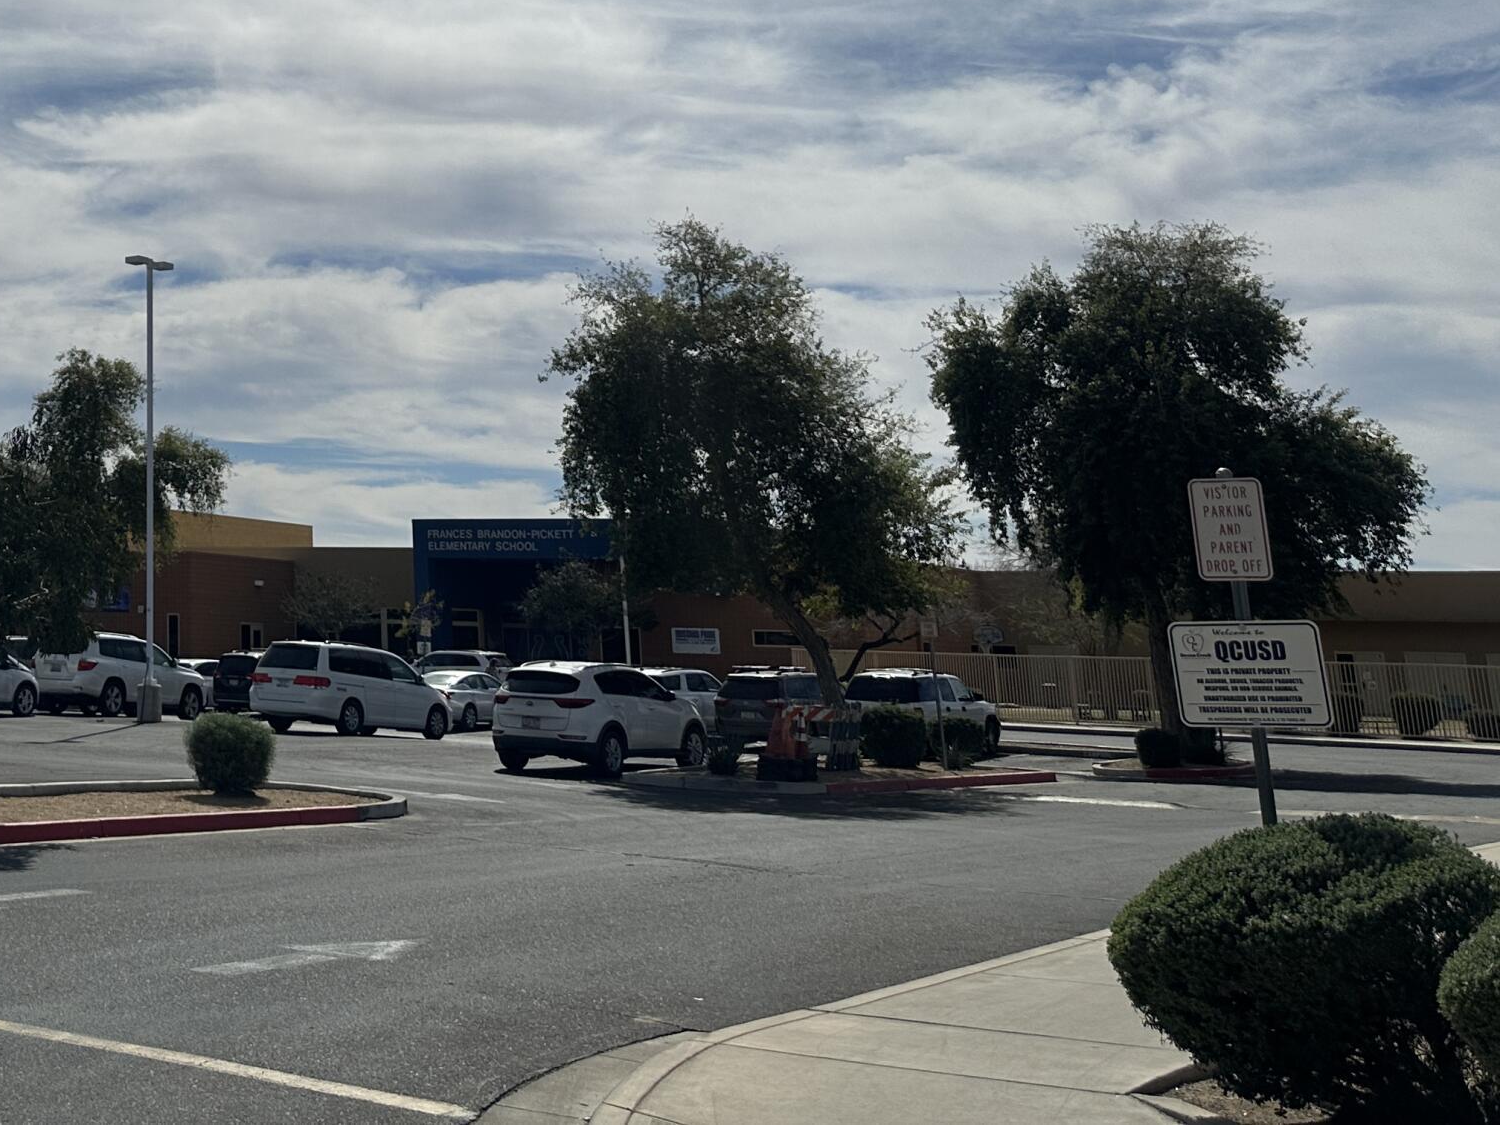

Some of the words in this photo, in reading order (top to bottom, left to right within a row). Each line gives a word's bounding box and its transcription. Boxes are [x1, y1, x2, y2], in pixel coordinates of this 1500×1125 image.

[1203, 504, 1253, 518] PARKING
[427, 529, 473, 539] FRANCES
[1219, 523, 1241, 536] AND
[427, 541, 491, 551] ELEMENTARY
[495, 541, 539, 552] SCHOOL
[1210, 541, 1253, 554] PARENT
[1206, 559, 1236, 573] DROP
[1242, 559, 1263, 573] OFF
[1212, 628, 1251, 636] Welcome
[1214, 640, 1286, 662] QCUSD
[1199, 706, 1242, 714] TRESPASSERS
[1260, 706, 1268, 714] BE
[1270, 706, 1312, 714] PROSECUTED
